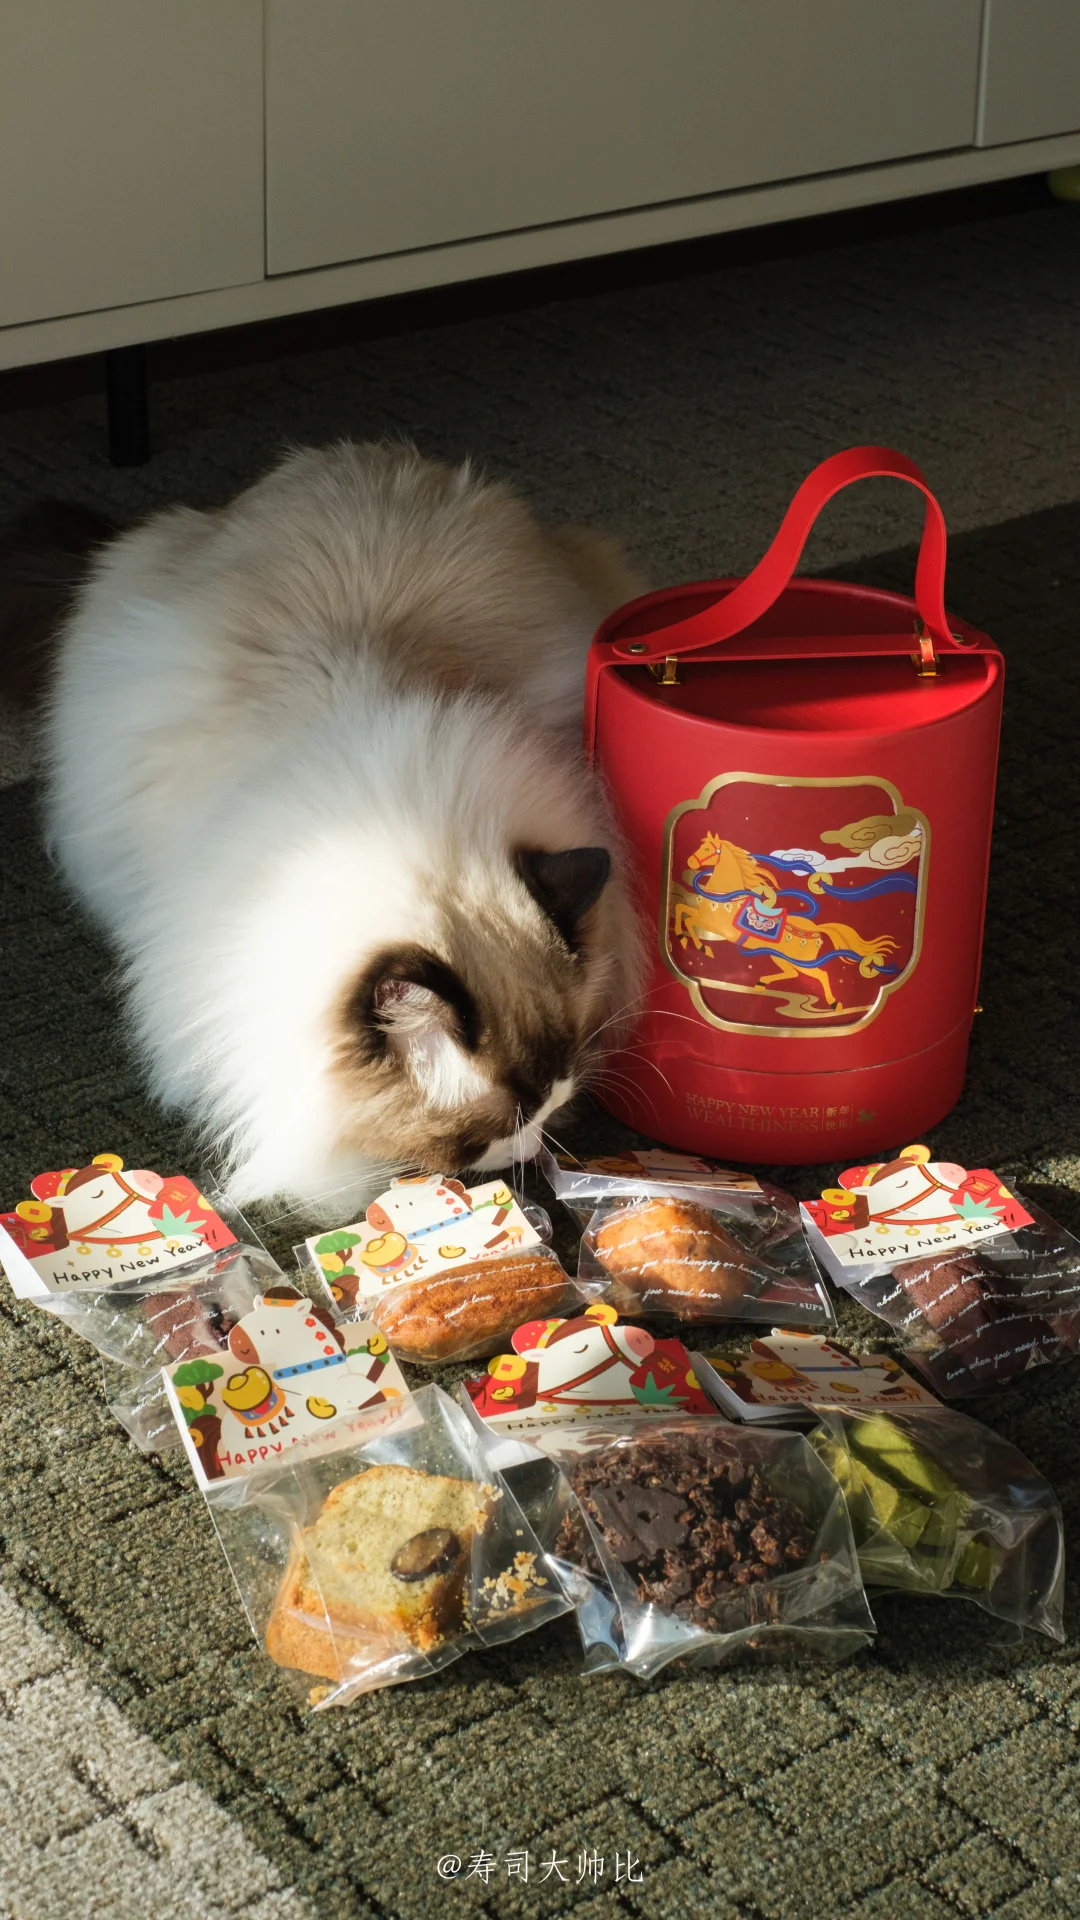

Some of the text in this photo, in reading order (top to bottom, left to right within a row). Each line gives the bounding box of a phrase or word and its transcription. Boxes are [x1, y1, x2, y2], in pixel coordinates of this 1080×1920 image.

[686, 1092, 820, 1118] HAPPY NEW YEAR
[825, 1106, 850, 1118] 新年
[825, 1119, 849, 1131] 快乐
[849, 1212, 1015, 1259] Happy New Year!!
[53, 1265, 114, 1284] Happy
[120, 1256, 160, 1273] New
[163, 1229, 217, 1258] Year!!
[752, 1392, 813, 1403] Happy
[820, 1395, 862, 1403] New
[507, 1417, 576, 1431] Happy
[586, 1410, 632, 1420] New
[215, 1441, 284, 1470] Happy
